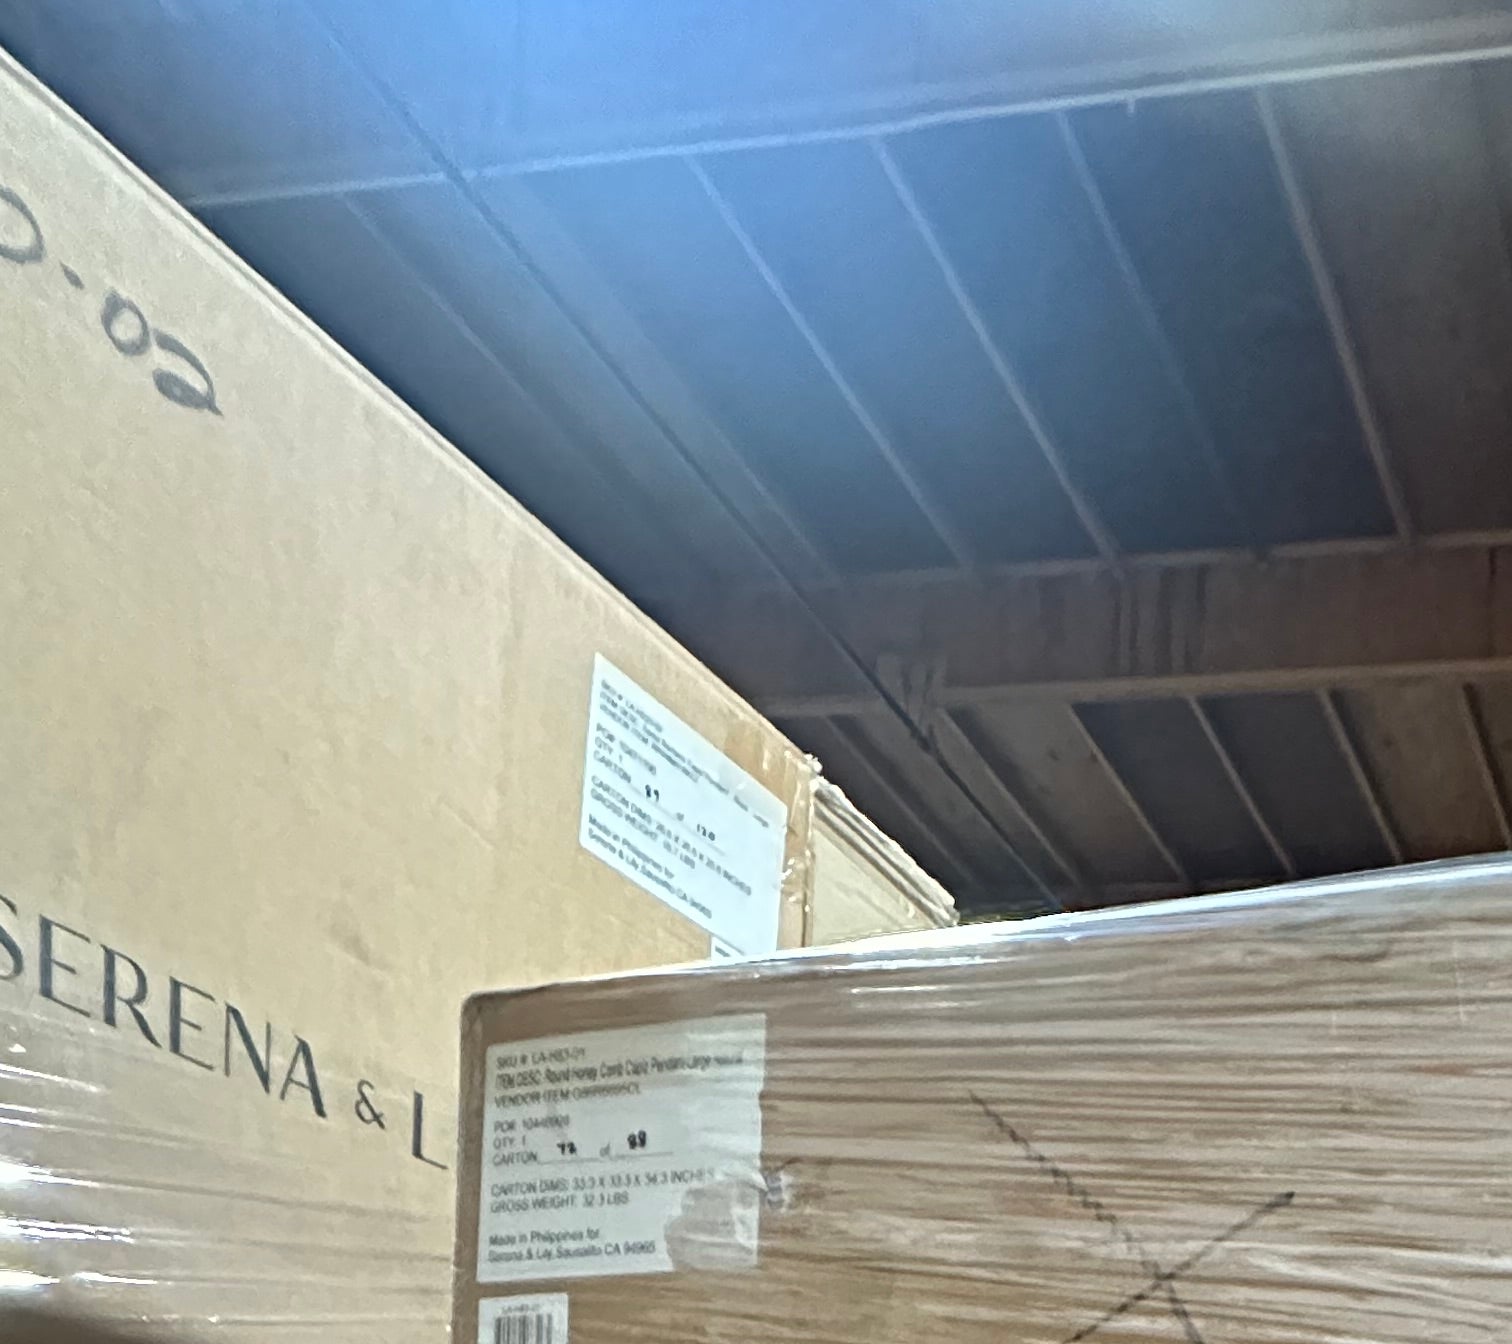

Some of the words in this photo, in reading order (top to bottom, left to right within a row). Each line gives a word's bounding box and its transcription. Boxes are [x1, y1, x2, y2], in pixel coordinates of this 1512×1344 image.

[593, 749, 631, 783] CARTON
[590, 774, 630, 809] CARTON
[0, 894, 327, 1119] SERENA
[354, 1079, 386, 1130] &
[495, 1090, 541, 1108] VENDOR
[492, 1150, 538, 1167] CARTON
[491, 1181, 537, 1197] CARTON
[490, 1199, 529, 1214] GROSS
[606, 1190, 629, 1205] LBS
[489, 1234, 516, 1247] Made
[604, 1242, 620, 1256] CA
